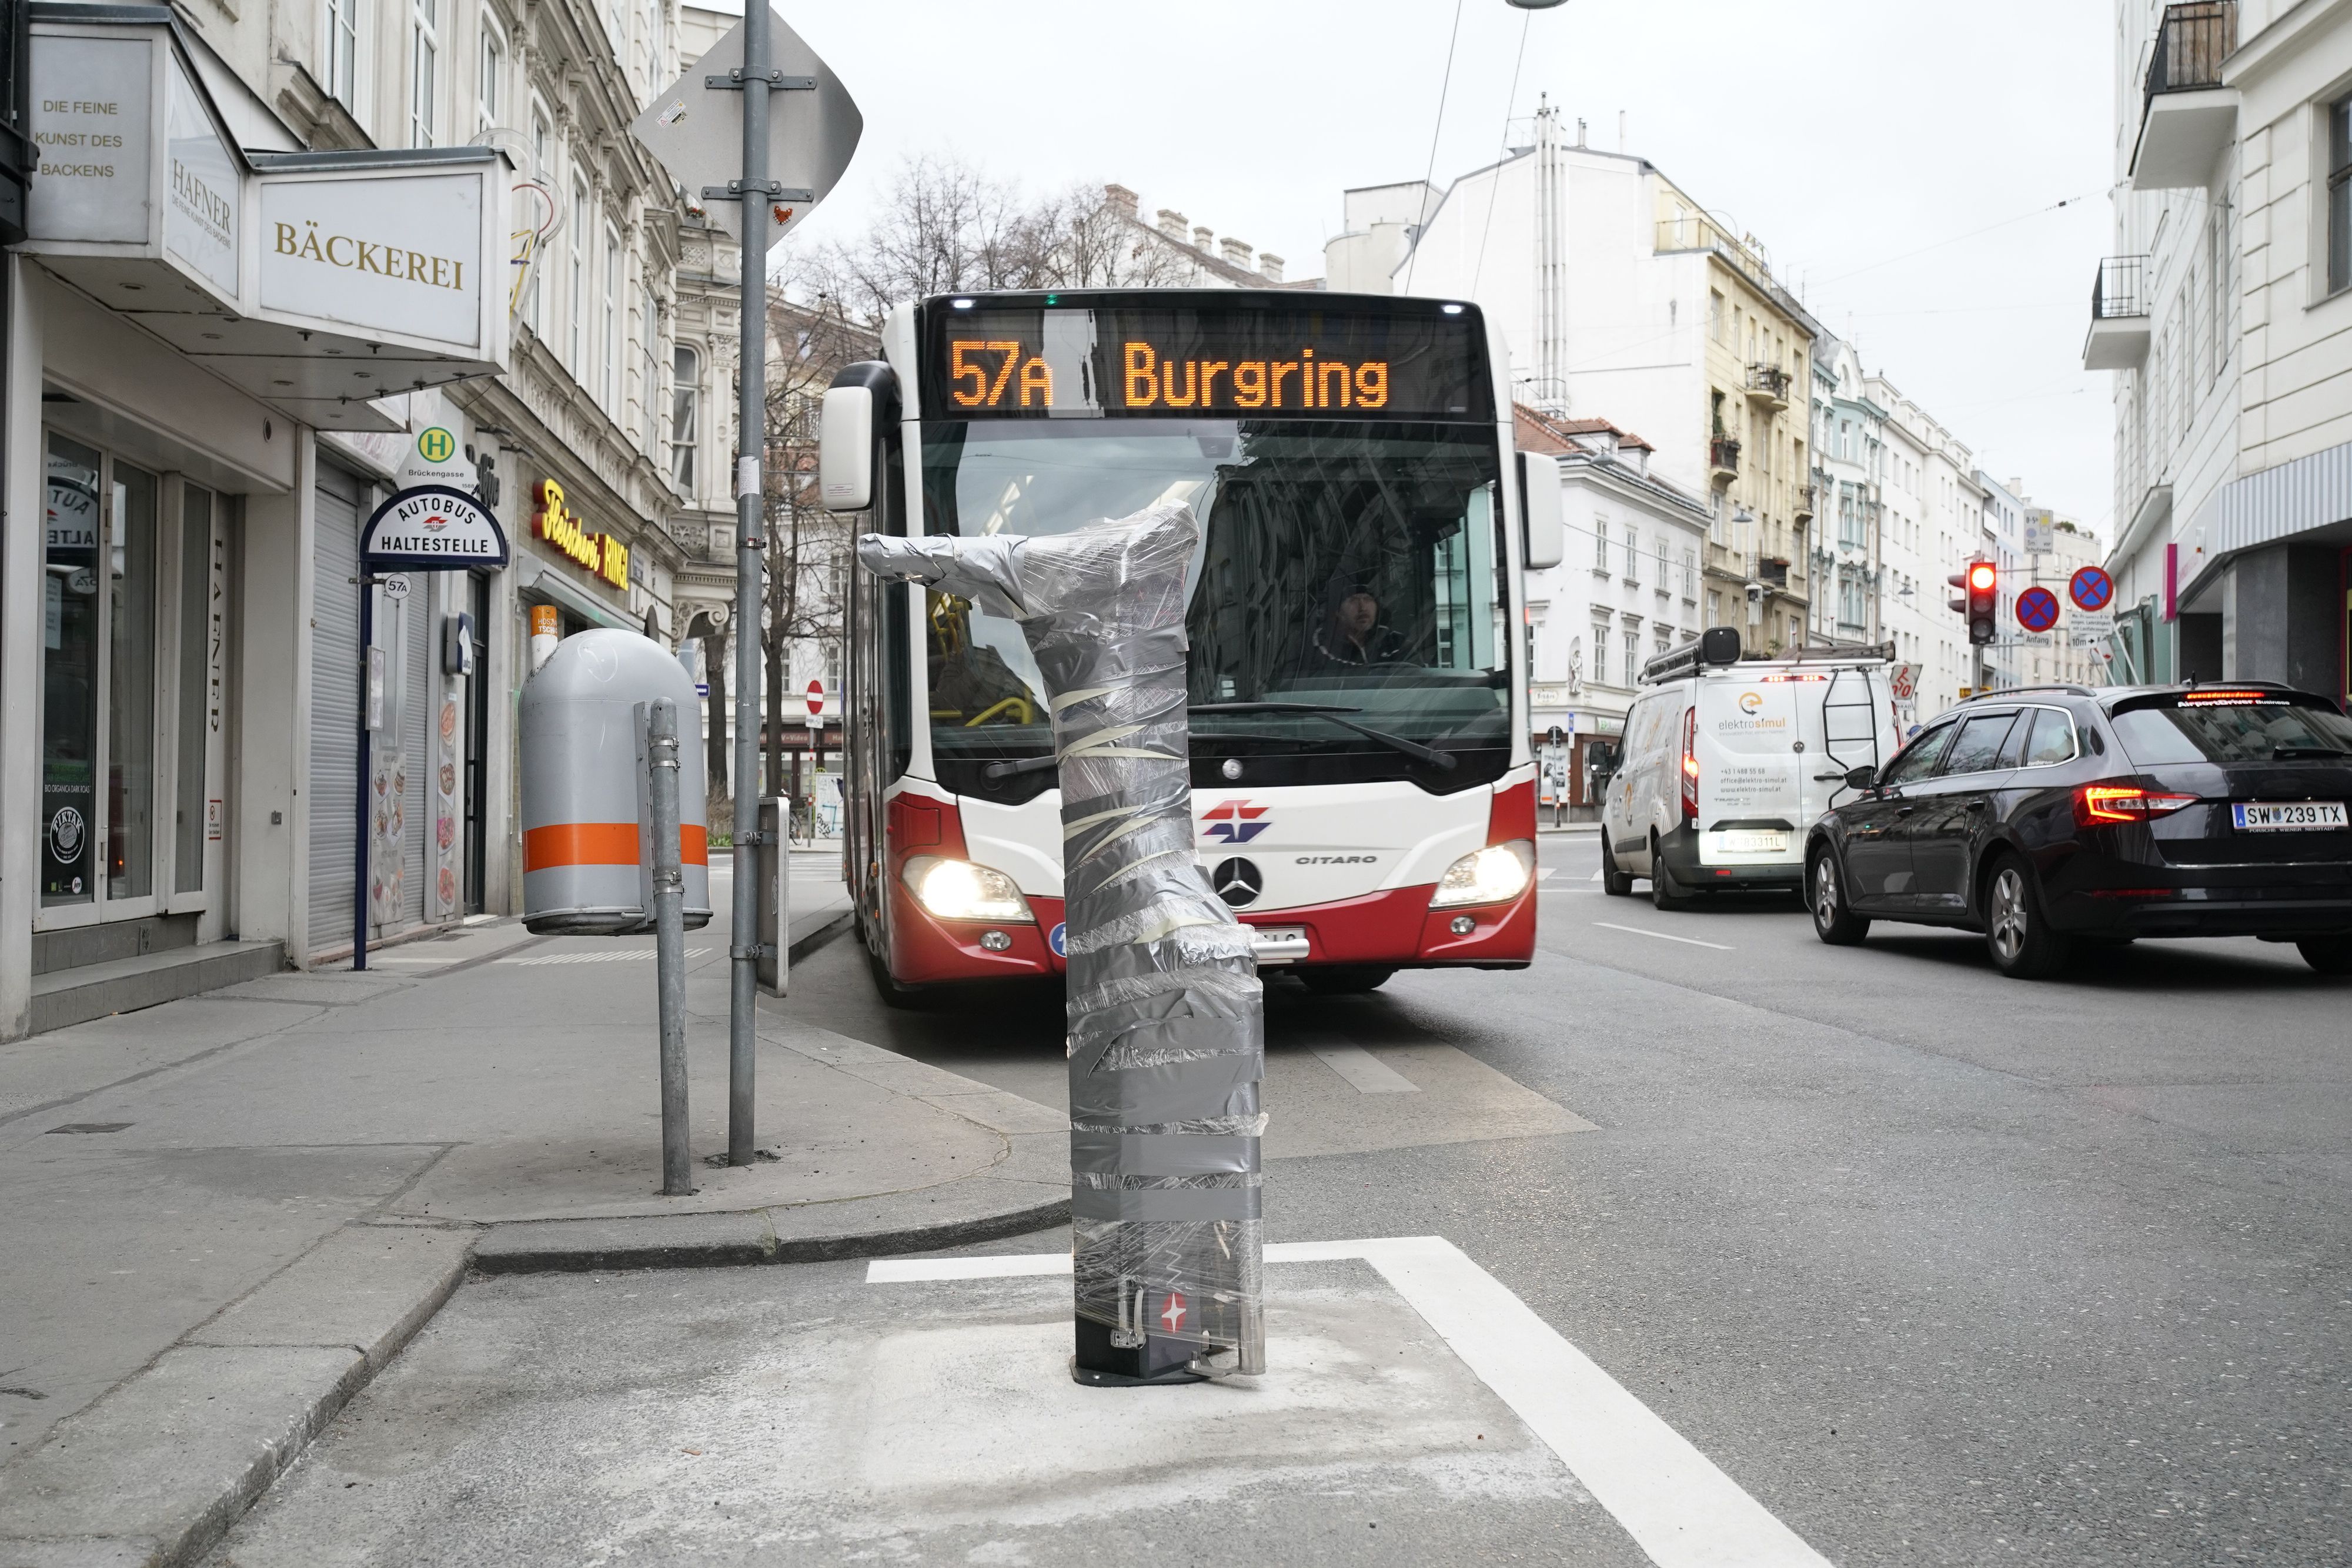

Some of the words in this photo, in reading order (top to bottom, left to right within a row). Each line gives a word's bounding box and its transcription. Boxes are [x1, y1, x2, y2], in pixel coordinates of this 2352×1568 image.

[44, 100, 68, 113] DIE
[74, 101, 118, 115] FEINE
[35, 132, 87, 146] KUNST
[92, 135, 122, 148] DES
[41, 164, 114, 177] BACKENS
[173, 158, 230, 235] HAFNER
[274, 220, 463, 290] BÄCKEREI
[953, 340, 1054, 406] 57A
[1124, 342, 1388, 407] Burgring
[427, 434, 446, 456] H
[408, 469, 465, 478] Brückengasse
[397, 497, 476, 524] AUTOBUS
[542, 478, 600, 571] Fleischerei
[604, 534, 629, 591] RINGL
[382, 536, 488, 553] HALTESTELLE
[387, 580, 407, 593] 57A
[211, 539, 222, 733] HAFNER
[2026, 636, 2049, 645] Anfang
[2072, 638, 2087, 647] 10m
[2177, 699, 2254, 707] AirportDriver
[1718, 717, 1786, 730] elektrosimul
[80, 785, 91, 794] ROAS
[53, 810, 82, 834] TIKTAK
[2247, 807, 2270, 824] SW
[2284, 807, 2316, 824] 239
[2319, 807, 2341, 823] TX
[1295, 856, 1378, 864] CITARO
